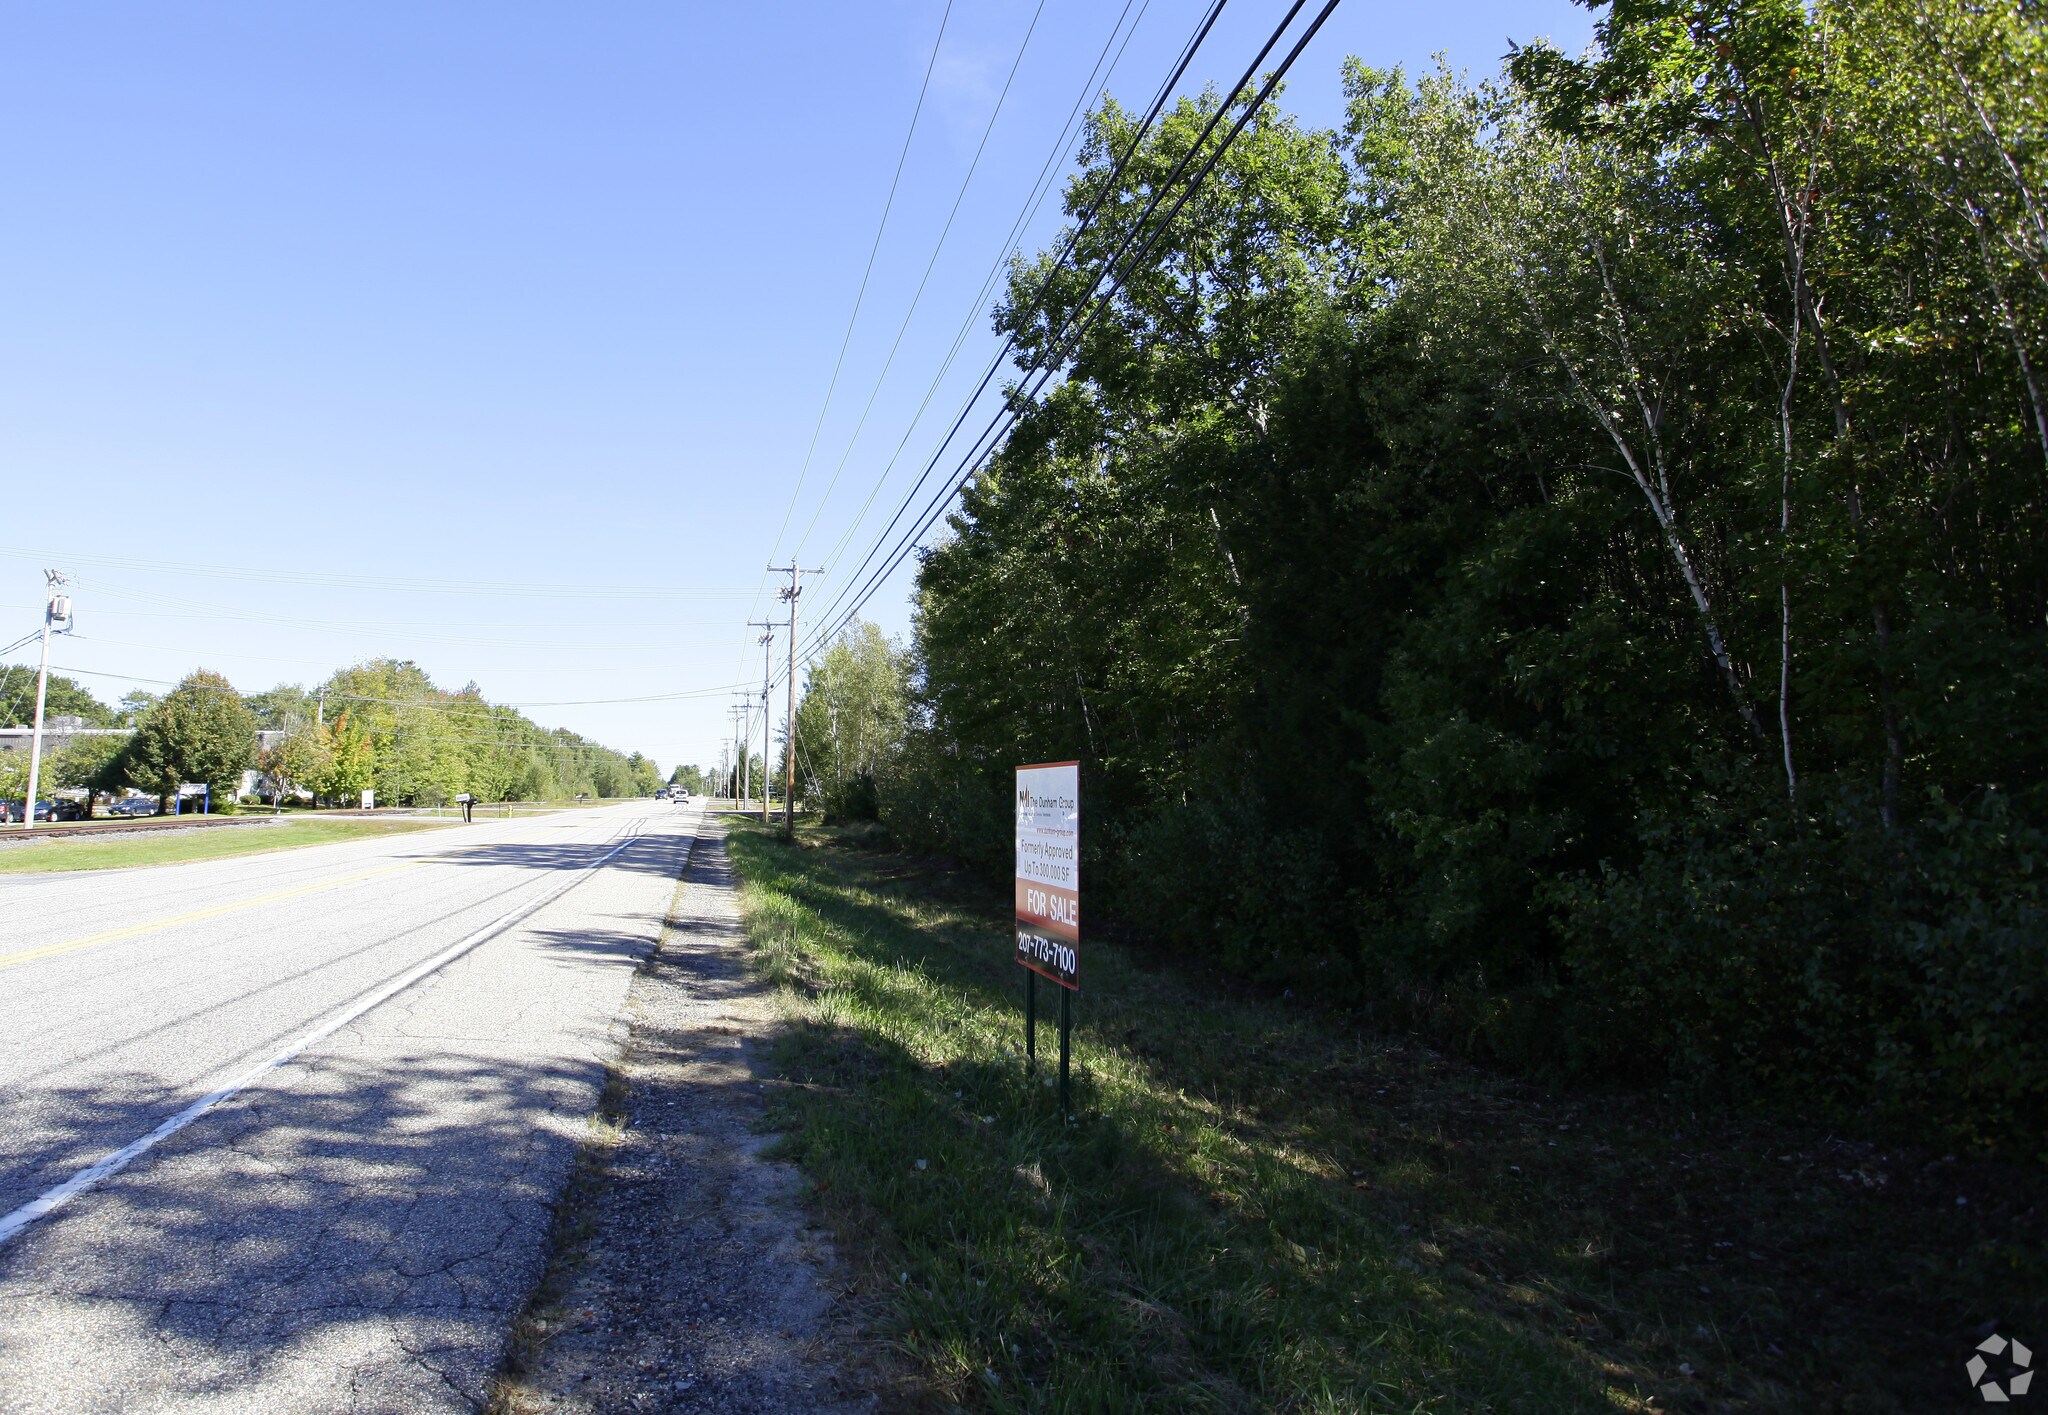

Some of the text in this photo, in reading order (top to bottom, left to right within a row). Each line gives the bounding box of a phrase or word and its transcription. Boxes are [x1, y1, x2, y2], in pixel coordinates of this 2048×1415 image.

[1039, 797, 1057, 808] Dunham
[1059, 796, 1074, 811] Group
[1021, 839, 1072, 860] Formerly Approved
[1024, 859, 1069, 881] Up To 300,000 SF
[1027, 889, 1076, 926] FOR SALE
[1019, 931, 1075, 974] 207-773-7100
